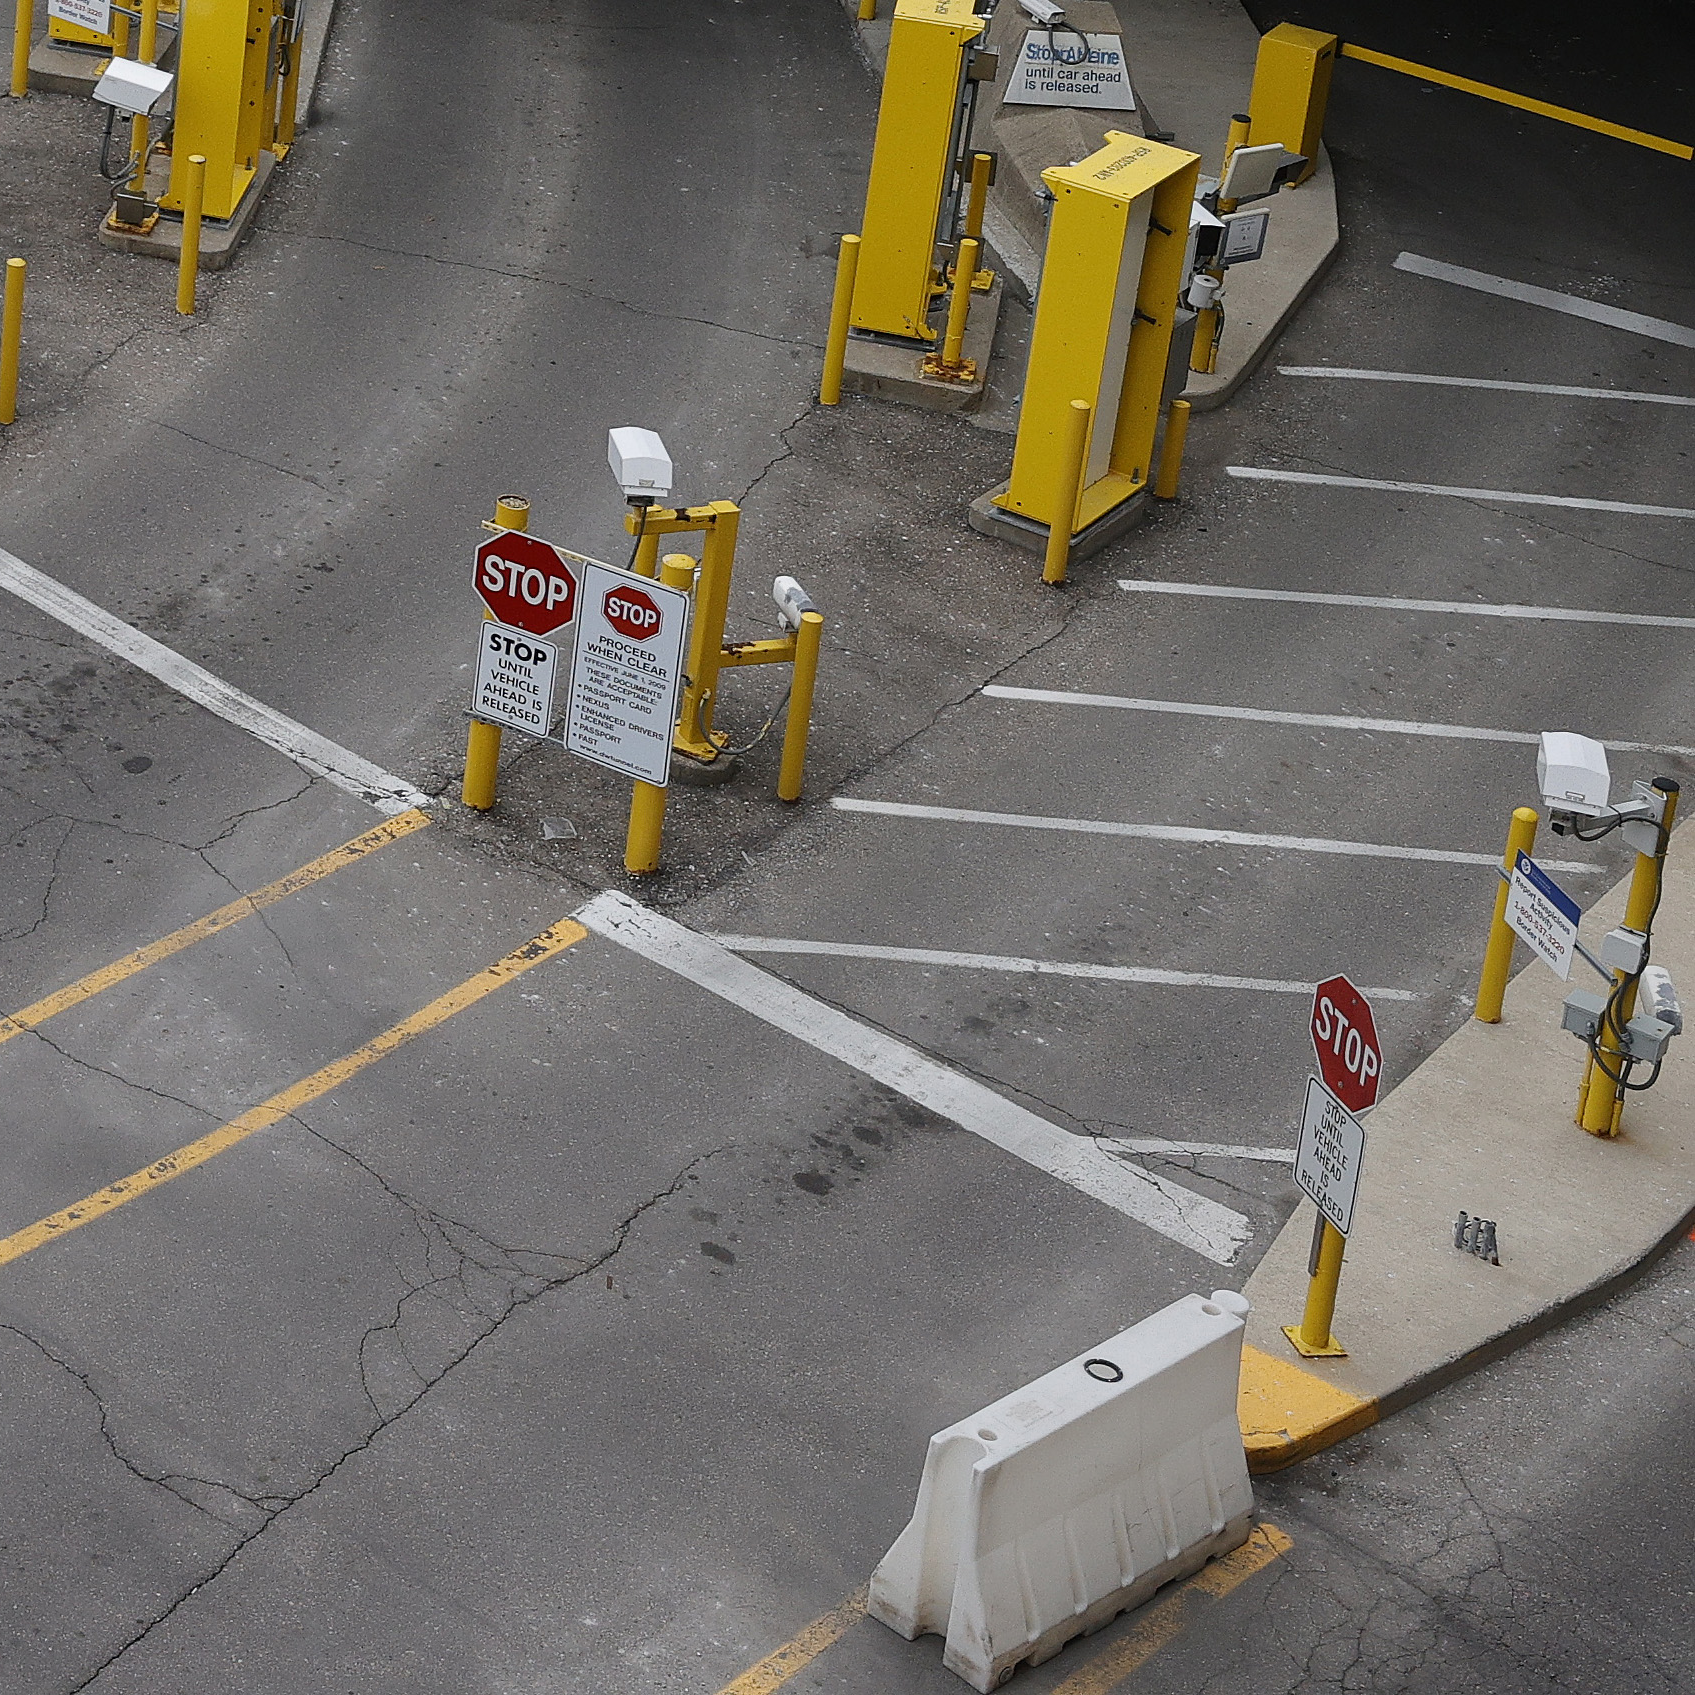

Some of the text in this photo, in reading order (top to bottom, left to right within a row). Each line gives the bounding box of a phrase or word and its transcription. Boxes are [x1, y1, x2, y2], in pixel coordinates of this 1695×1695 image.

[1025, 79, 1102, 94] is released.
[1026, 67, 1121, 83] until car ahead
[482, 555, 569, 610] STOP
[608, 596, 657, 628] STOP
[489, 633, 547, 665] STOP
[587, 643, 667, 678] WHEN CLEAR
[599, 636, 656, 662] PROCEED
[491, 670, 539, 695] VEHICLE
[498, 658, 533, 679] UNTIL
[586, 667, 662, 699] THESE DOCUMENTS
[589, 676, 604, 687] ARE
[482, 696, 540, 725] RELEASED
[484, 683, 542, 711] AHEAD IS
[582, 695, 610, 710] NEXUS
[583, 685, 651, 715] PASSPORT CARD
[579, 723, 621, 745] PASSPORT
[581, 713, 614, 732] LICENSE
[581, 706, 664, 741] ENHANCED DRIVERS
[579, 734, 598, 746] FAST
[1515, 876, 1536, 900] Report
[1537, 898, 1571, 935] Suspicious
[1530, 903, 1553, 930] Activity
[1517, 916, 1557, 962] Border Watch
[1315, 996, 1378, 1087] STOP
[1325, 1100, 1347, 1127] STOP
[1321, 1114, 1344, 1148] UNTIL
[1313, 1124, 1348, 1171] VEHICLE
[1313, 1146, 1342, 1182] AHEAD
[1320, 1170, 1329, 1188] IS
[1301, 1171, 1344, 1222] RELEASED
